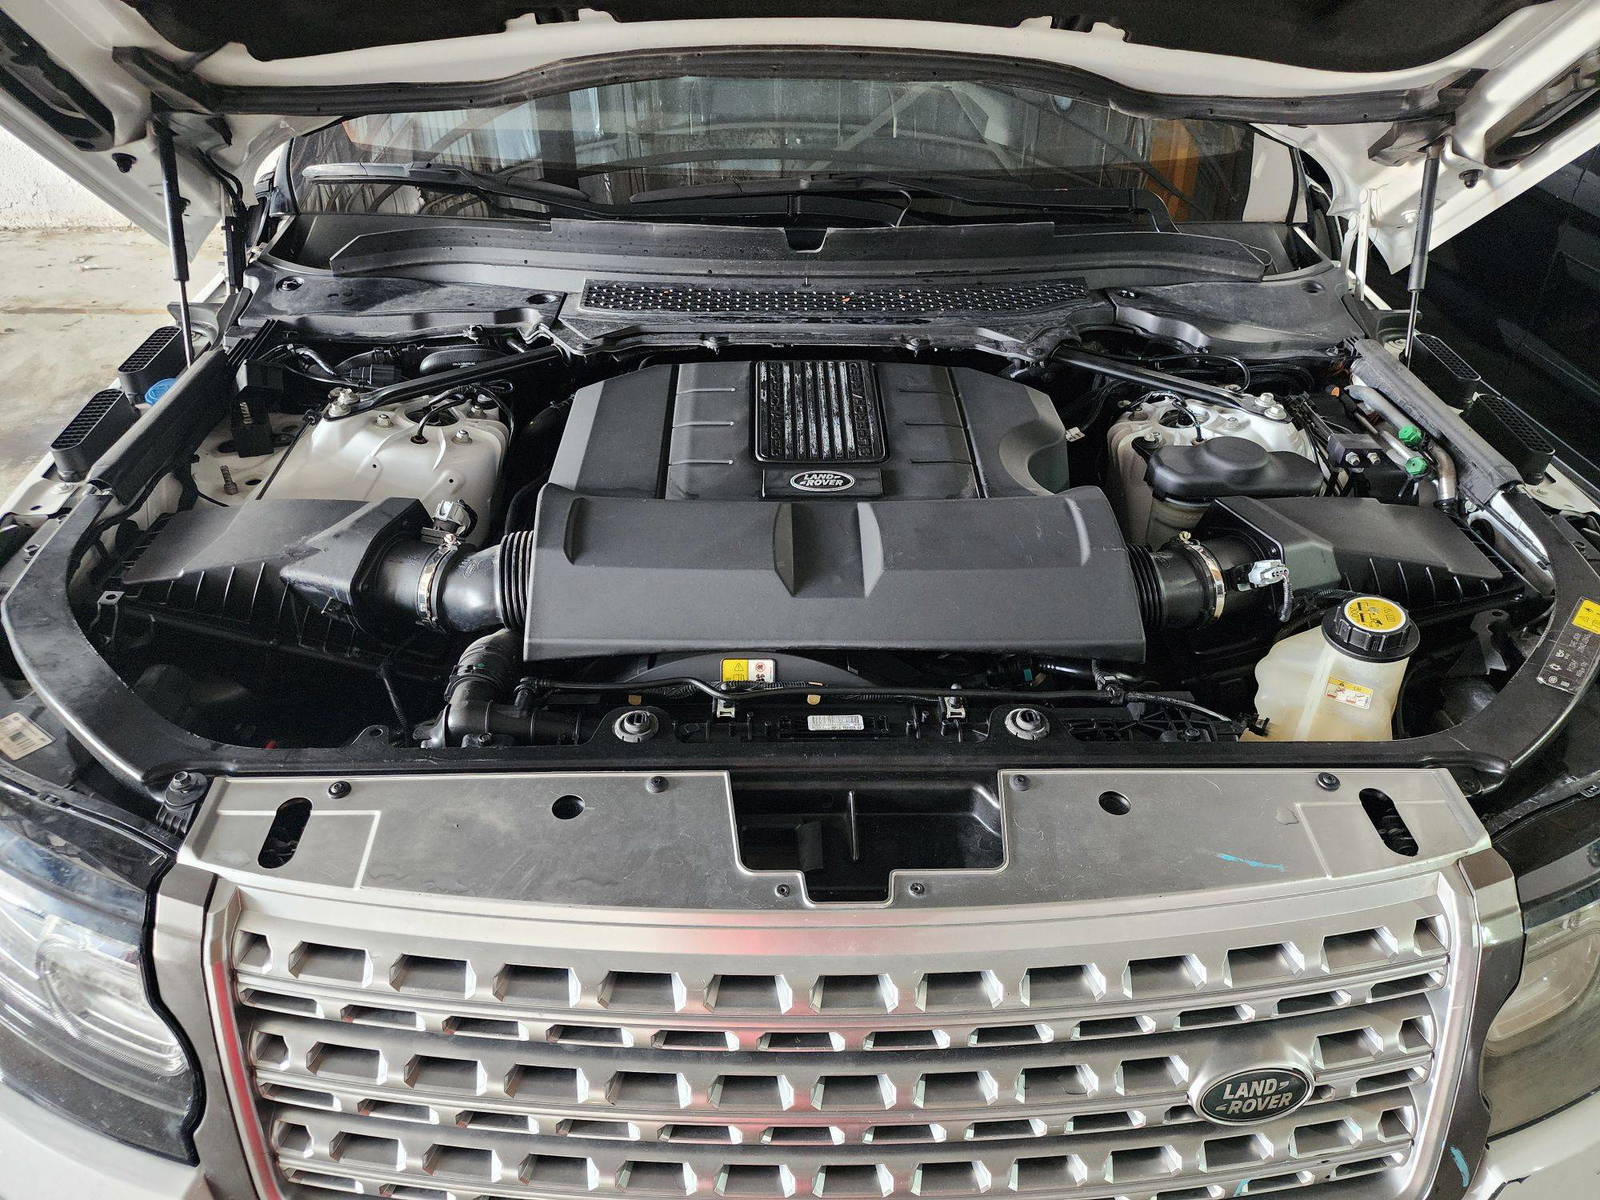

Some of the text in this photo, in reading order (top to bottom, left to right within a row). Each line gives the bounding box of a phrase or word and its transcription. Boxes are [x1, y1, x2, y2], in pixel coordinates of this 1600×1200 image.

[803, 473, 835, 481] LAND
[805, 479, 844, 487] ROVER
[1223, 1078, 1279, 1100] LAND
[1225, 1092, 1293, 1115] ROVER
